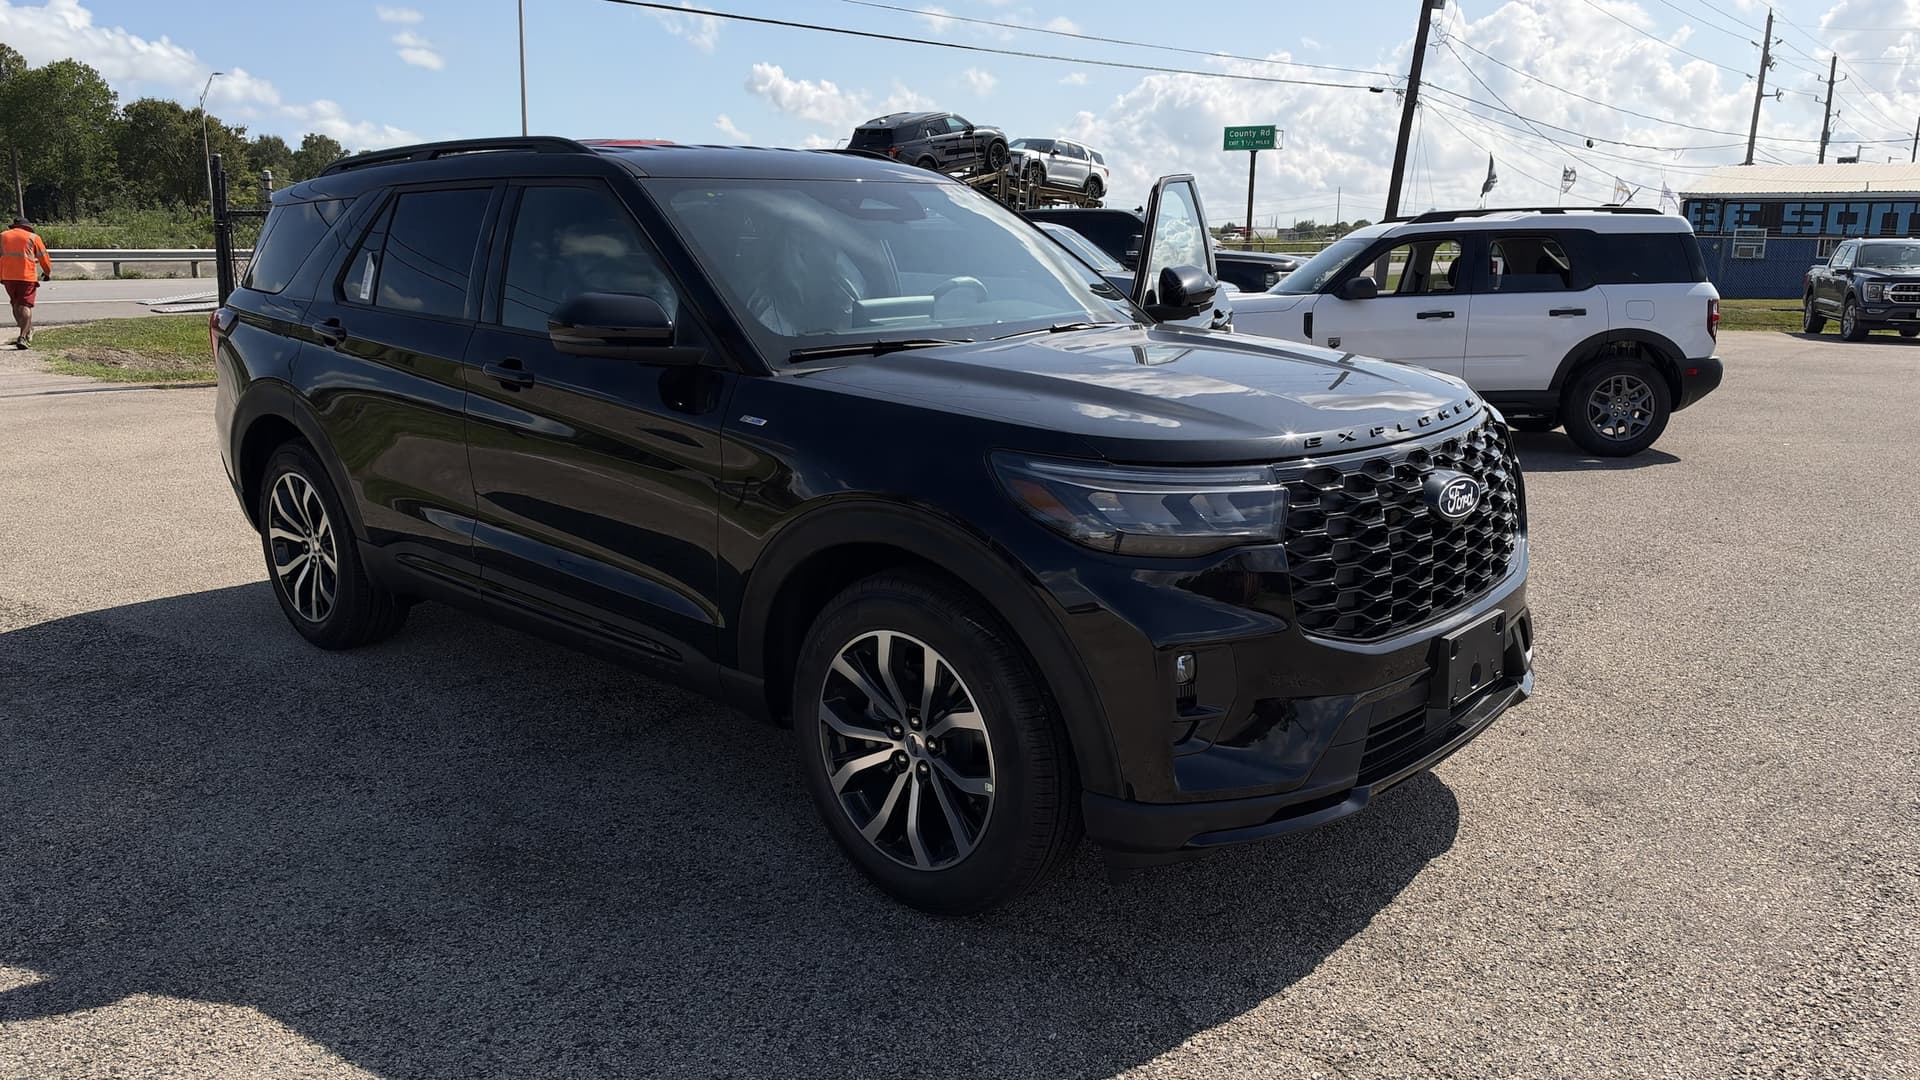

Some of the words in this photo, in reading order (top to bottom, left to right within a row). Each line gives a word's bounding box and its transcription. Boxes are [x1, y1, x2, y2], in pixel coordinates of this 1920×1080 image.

[1230, 130, 1256, 138] County
[1688, 203, 1760, 232] BE
[1448, 483, 1475, 512] Ford
